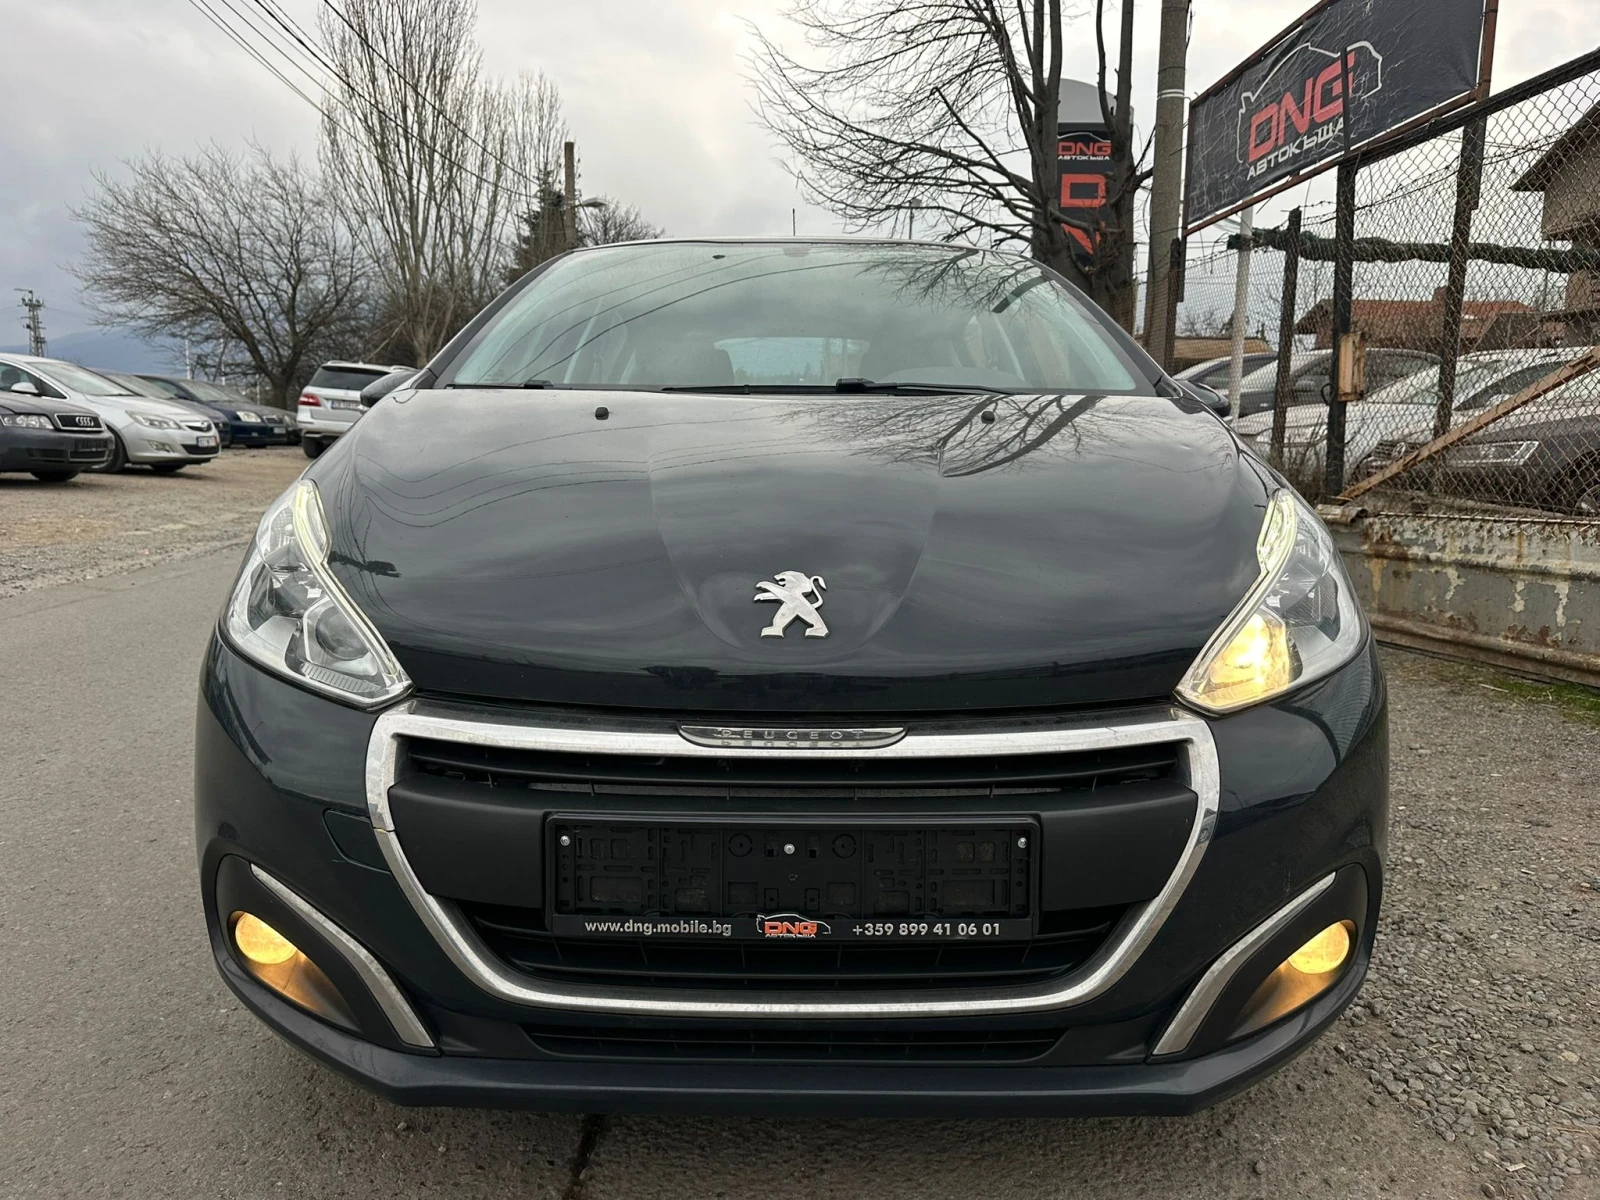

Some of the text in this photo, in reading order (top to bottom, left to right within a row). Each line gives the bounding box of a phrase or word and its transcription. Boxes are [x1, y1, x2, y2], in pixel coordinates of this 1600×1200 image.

[1248, 51, 1356, 163] DNG
[1058, 142, 1111, 155] DNG
[720, 729, 864, 740] PEUGEOT
[584, 919, 732, 936] www.dng.mobile.bg
[764, 921, 817, 934] DNG
[852, 923, 1000, 936] +359 899 41 06 01
